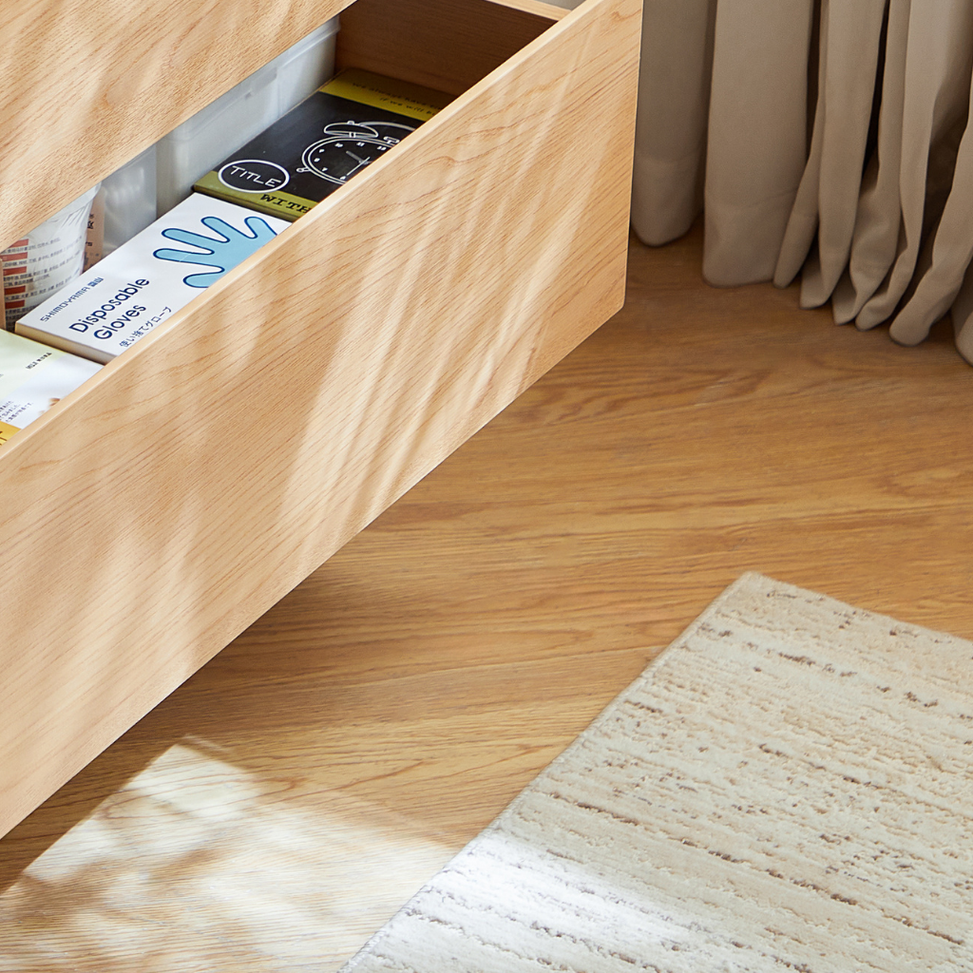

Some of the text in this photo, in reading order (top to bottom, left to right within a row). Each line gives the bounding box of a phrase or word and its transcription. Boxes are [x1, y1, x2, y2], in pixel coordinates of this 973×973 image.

[230, 165, 282, 187] TITLE
[260, 194, 312, 214] WITH
[40, 285, 90, 322] SHIMOYAMA
[69, 278, 150, 333] Disposable
[94, 304, 147, 340] Gloves
